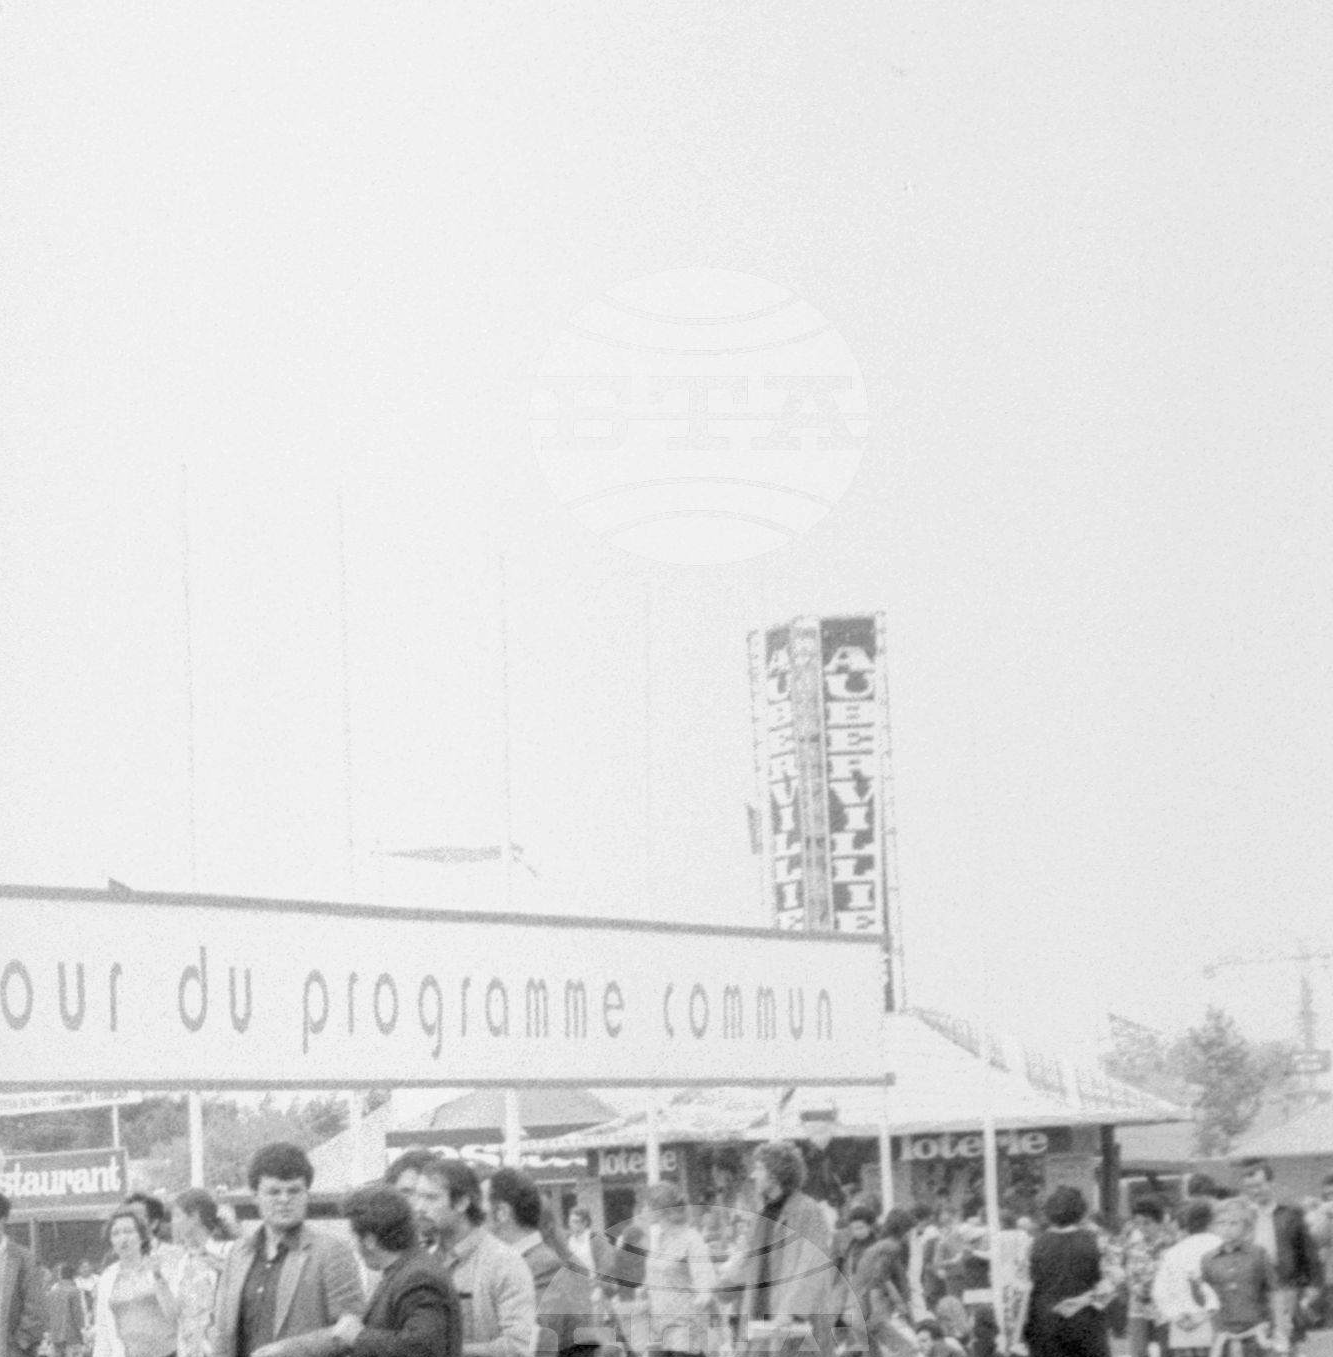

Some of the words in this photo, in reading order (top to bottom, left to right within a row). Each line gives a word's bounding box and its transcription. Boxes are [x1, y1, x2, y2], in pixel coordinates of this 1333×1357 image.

[178, 946, 253, 1034] du
[302, 971, 625, 1059] programme
[663, 981, 834, 1041] commun
[598, 1147, 678, 1176] lotee
